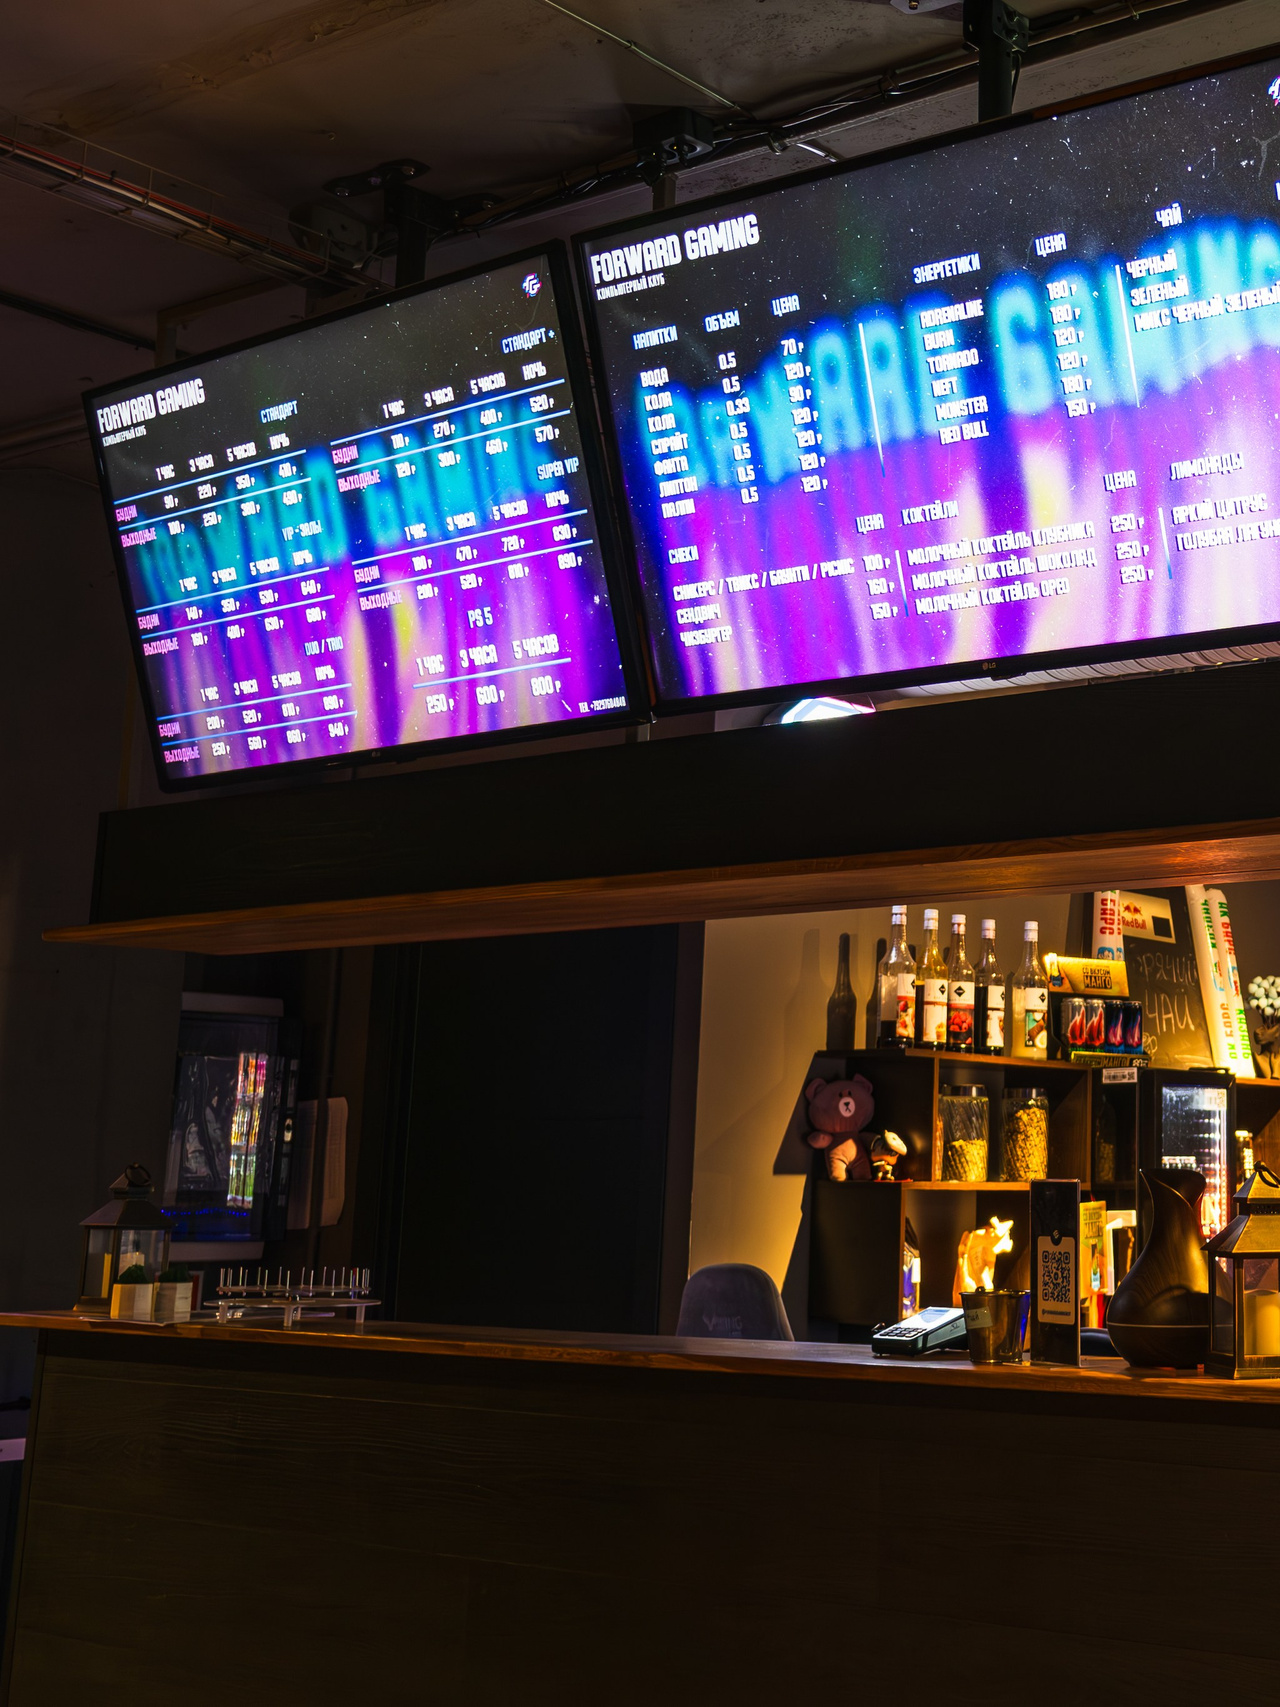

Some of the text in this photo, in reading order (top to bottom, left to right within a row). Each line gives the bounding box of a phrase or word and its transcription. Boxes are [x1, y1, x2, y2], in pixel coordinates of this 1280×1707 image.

[1155, 203, 1182, 227] ЧАЙ
[591, 214, 759, 283] FORWARD GAMING
[1036, 233, 1065, 257] ЦЕНА
[913, 253, 979, 284] ЭНЕРГЕТИКИ
[1126, 249, 1176, 278] ЧЕРНЫЙ
[1130, 275, 1187, 305] ЗЕЛЕНЫЙ
[772, 295, 799, 317] ЦЕНА
[920, 300, 983, 328] ADRENALINE
[1134, 309, 1169, 330] МИКС
[1172, 295, 1222, 323] ЧЕРНЫЙ
[705, 310, 739, 331] ОБЪЕМ
[502, 328, 547, 354] СТАНДАРТ
[633, 325, 677, 348] НАПИТКИ
[924, 330, 953, 350] BURN
[523, 361, 545, 379] НОЧЬ
[641, 339, 796, 388] ВОДА 0.5 70
[927, 349, 978, 373] TORNADO
[644, 362, 804, 410] КОЛА 0.5 120
[932, 377, 958, 396] NEFT
[97, 378, 205, 432] FORWARD GAMING
[261, 401, 298, 424] СТАНДАРТ
[648, 414, 675, 432] КОЛА
[726, 397, 749, 415] 0.33
[935, 396, 987, 420] MONSTER
[651, 407, 811, 454] СПРАЙТ 0.5 120
[939, 426, 960, 443] RED
[962, 421, 988, 439] BULL
[332, 445, 358, 465] БУДНИ
[654, 430, 815, 475] ФАНТА 0.5 120
[538, 457, 579, 479] SUPER VIP
[737, 466, 755, 482] 0.5
[799, 453, 818, 470] 120
[1170, 452, 1243, 481] ЛИМОНАДЫ
[338, 470, 380, 493] ВЫХОДНЫЕ
[740, 487, 758, 503] 0.5
[802, 476, 821, 492] 120
[1104, 471, 1136, 492] ЦЕНА
[116, 505, 137, 522] БУДНИ
[901, 498, 958, 524] КОКТЕЙЛИ
[282, 527, 294, 541] VIP
[856, 514, 883, 533] ЦЕНА
[121, 527, 156, 548] ВЫХОДНЫЕ
[907, 539, 970, 565] МОЛОЧНЫЙ
[971, 529, 1030, 555] КОКТЕЙЛЬ
[668, 546, 698, 563] СНЕКИ
[673, 581, 715, 600] СНИКЕРС
[863, 554, 883, 570] 100
[911, 564, 975, 590] МОЛОЧНЫЙ
[975, 554, 1034, 580] КОКТЕЙЛЬ
[1036, 548, 1096, 573] ШОКОЛАД
[915, 589, 979, 614] МОЛОЧНЫЙ
[979, 580, 1038, 605] КОКТЕЙЛЬ
[468, 609, 483, 627] PS
[677, 604, 721, 625] СЕНДВИЧ
[523, 634, 558, 656] ЧАСОВ
[680, 626, 732, 646] ЧИЗБУРГЕР
[423, 655, 444, 673] ЧАС
[469, 645, 497, 665] ЧАСА
[1099, 898, 1116, 935] БАРС
[1083, 975, 1113, 989] МАНГО
[1145, 988, 1196, 1036] ЧАЙ
